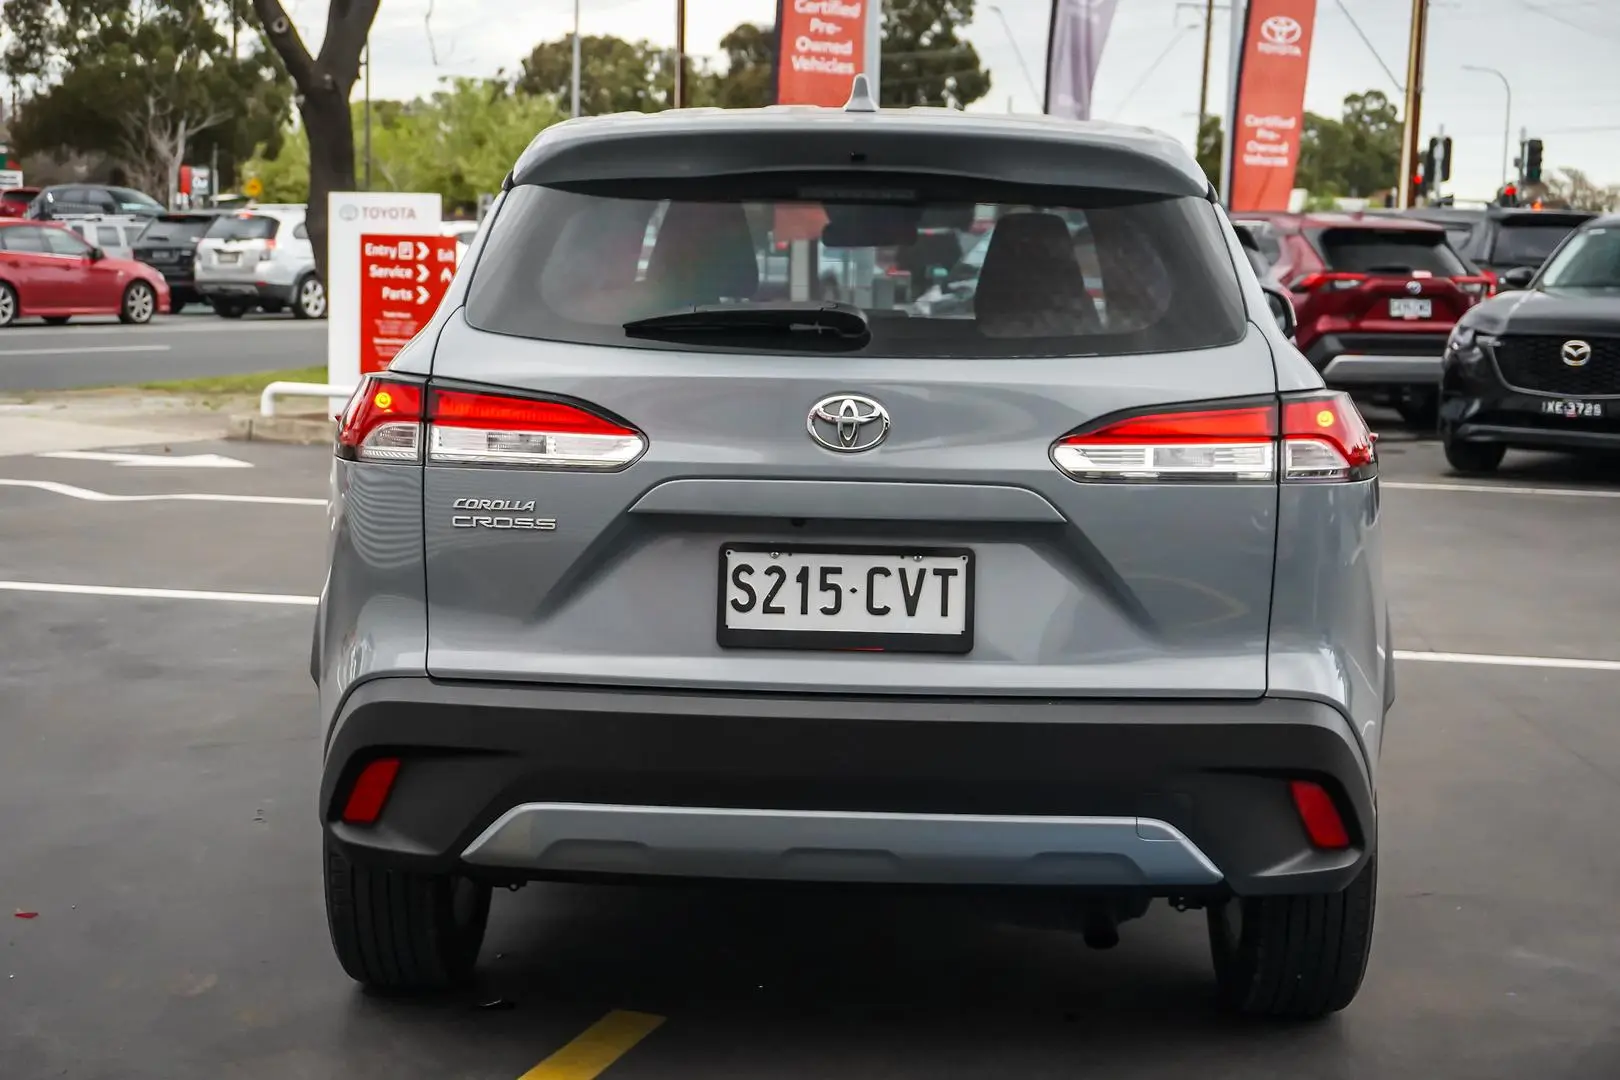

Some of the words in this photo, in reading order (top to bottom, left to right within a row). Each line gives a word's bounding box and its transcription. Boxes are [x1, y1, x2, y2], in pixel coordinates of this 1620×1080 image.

[795, 35, 853, 56] Owned
[791, 54, 855, 75] Vehicles
[362, 206, 416, 220] TOYOTA
[364, 242, 397, 260] Entry
[368, 264, 413, 280] Service
[381, 286, 413, 301] Parts
[452, 498, 536, 511] COROLLA
[452, 515, 556, 530] CROSS
